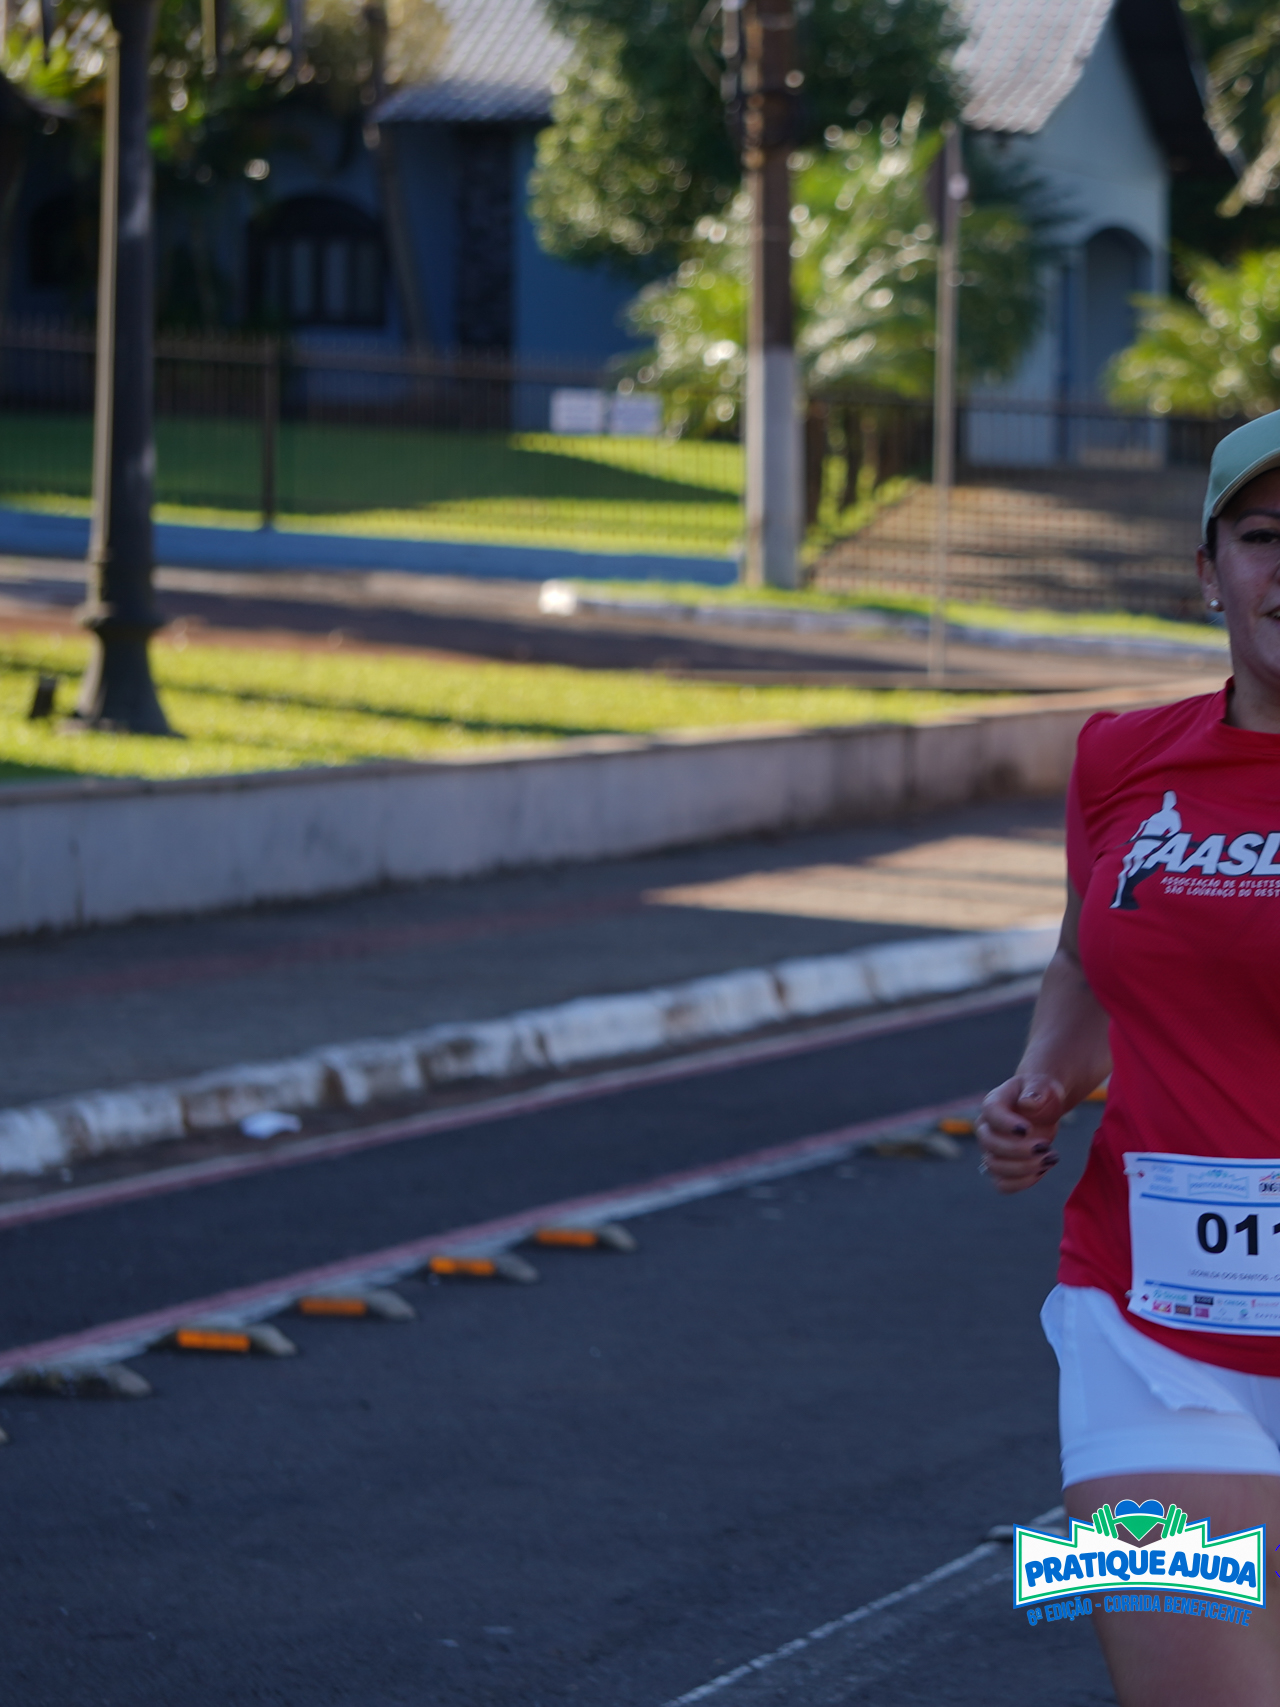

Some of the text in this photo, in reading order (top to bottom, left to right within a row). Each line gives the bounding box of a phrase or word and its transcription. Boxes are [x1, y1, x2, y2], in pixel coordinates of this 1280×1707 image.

[1222, 879, 1236, 889] DE
[1186, 887, 1236, 898] LOURENÇO
[1238, 888, 1252, 898] DO
